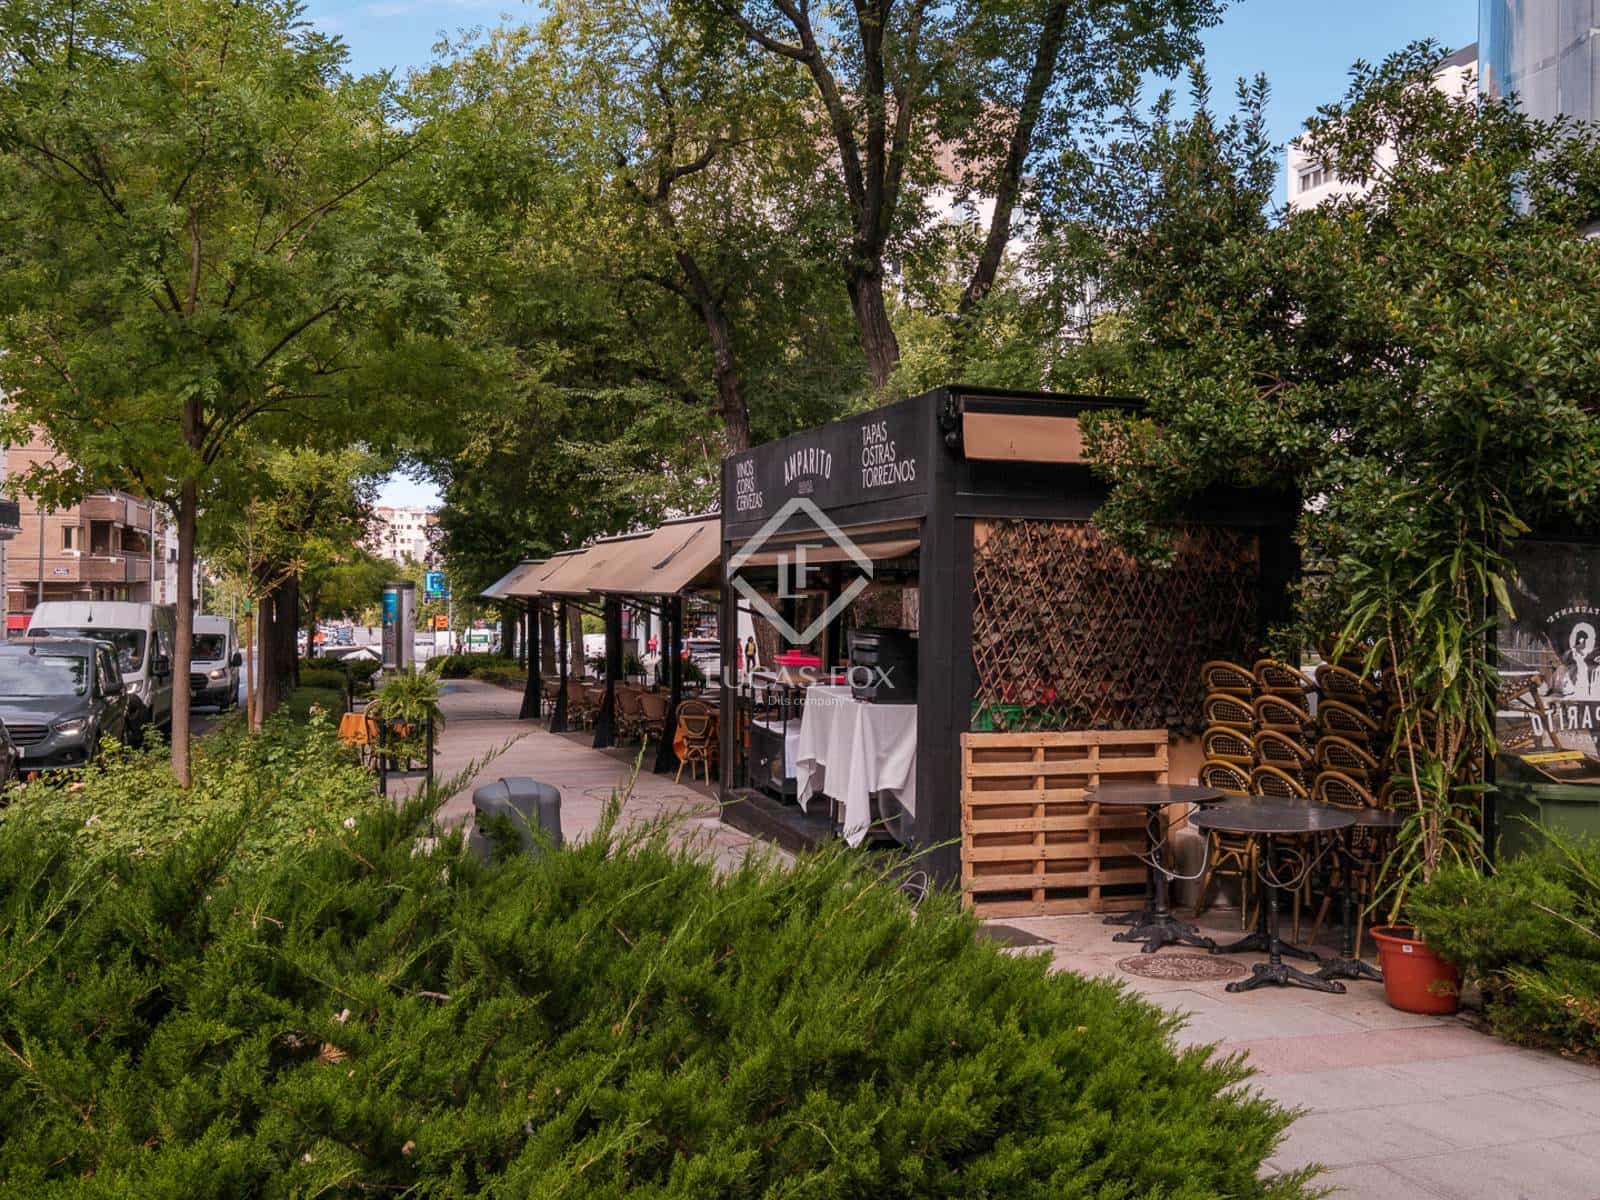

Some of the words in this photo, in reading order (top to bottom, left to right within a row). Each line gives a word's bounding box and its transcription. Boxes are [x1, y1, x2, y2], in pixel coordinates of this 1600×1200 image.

[862, 420, 888, 446] TAPAS
[862, 440, 896, 467] OSTRAS
[736, 459, 754, 478] VINOS
[784, 447, 832, 487] AMPARITO
[862, 459, 916, 489] TORREZNOS
[736, 476, 755, 495] COPAS
[736, 491, 763, 512] CERVEZAS
